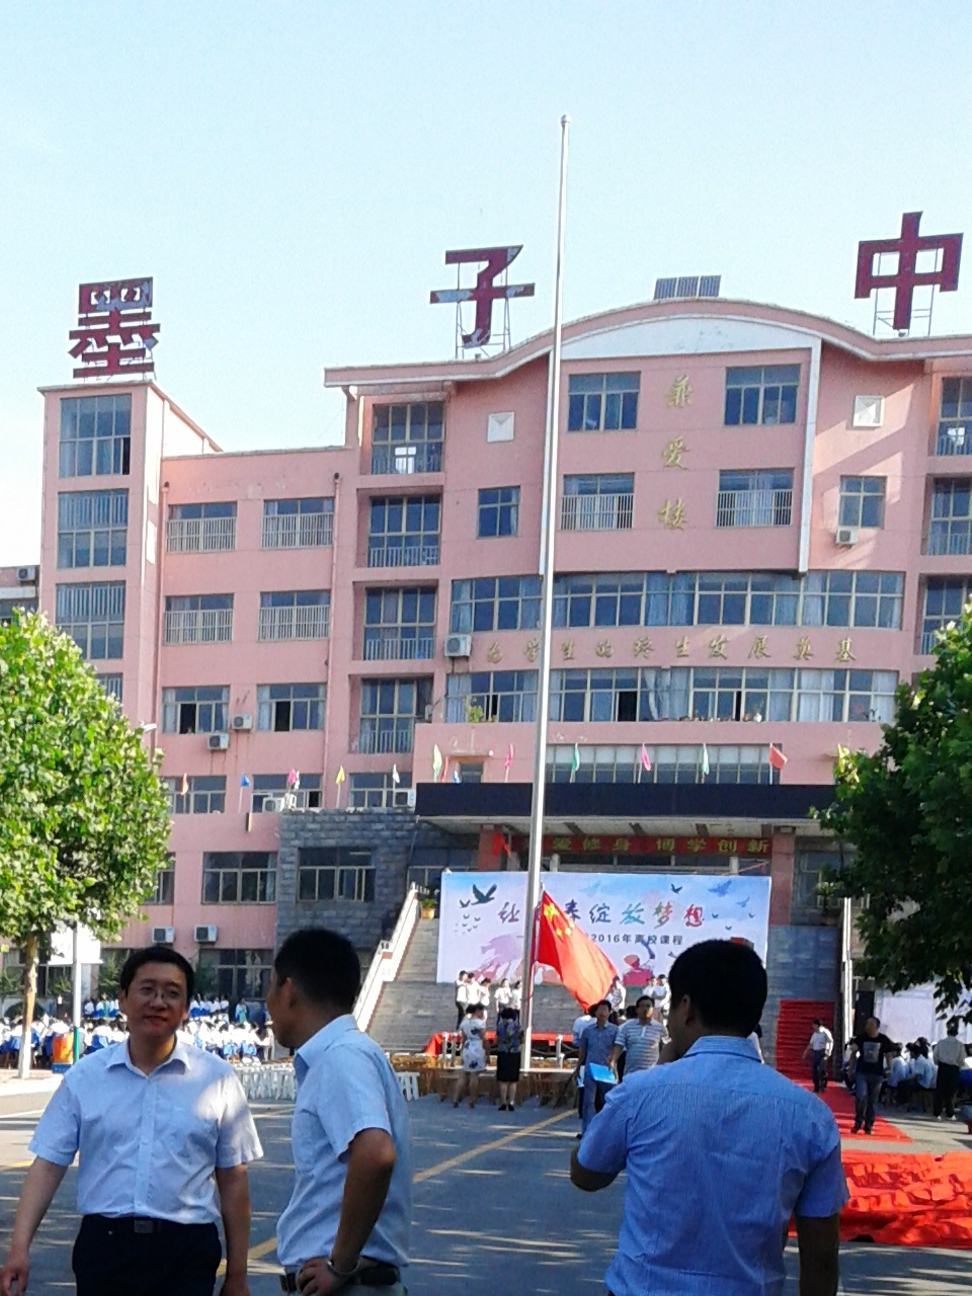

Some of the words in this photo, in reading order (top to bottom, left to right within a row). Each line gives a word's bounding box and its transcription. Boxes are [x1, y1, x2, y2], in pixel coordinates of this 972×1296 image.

[498, 899, 705, 928] 让春绽放梦想
